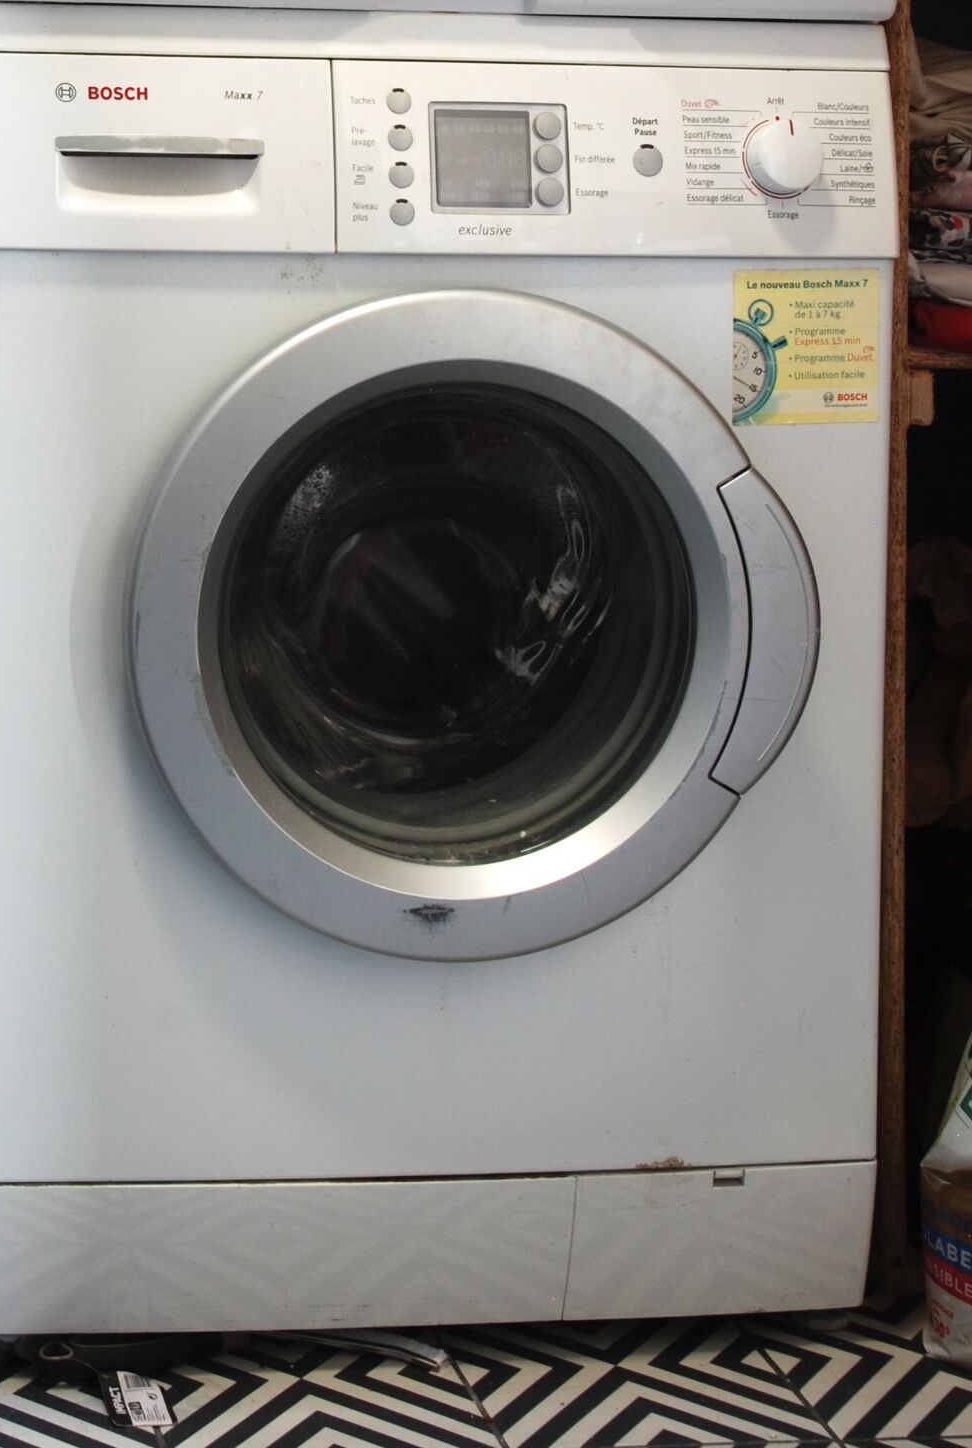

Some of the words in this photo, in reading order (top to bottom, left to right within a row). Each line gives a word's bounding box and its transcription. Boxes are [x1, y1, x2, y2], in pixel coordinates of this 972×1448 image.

[88, 86, 149, 100] BOSCH
[224, 90, 253, 100] Maxx
[257, 91, 263, 100] 7
[350, 97, 376, 105] Taches
[681, 100, 703, 108] Duvet
[767, 97, 784, 105] Arrêt
[818, 103, 869, 111] Blanc/Couleurs
[632, 118, 658, 126] Départ
[682, 116, 699, 124] Peau
[701, 115, 730, 123] sensible
[813, 118, 843, 126] Couleurs
[845, 118, 870, 127] intensif
[574, 122, 595, 131] Temp.
[683, 131, 732, 140] Sport/Fitness
[829, 134, 858, 142] Couleurs
[860, 134, 872, 143] éco
[351, 138, 376, 147] lavage
[685, 147, 712, 156] Express
[723, 147, 736, 155] min
[832, 149, 873, 158] Délicat/Soie
[575, 155, 586, 163] Fin
[587, 155, 615, 164] différée
[352, 164, 374, 172] Facile
[699, 163, 720, 171] rapide
[686, 178, 714, 187] Vidange
[830, 180, 875, 190] Synthétiques
[576, 189, 608, 198] Essorage
[687, 194, 719, 203] Essorage
[720, 194, 743, 202] délicat
[849, 196, 876, 205] Rinçage
[352, 214, 368, 222] plus
[768, 210, 799, 220] Essorage
[458, 224, 512, 236] exclusive
[746, 281, 757, 289] Le
[760, 281, 801, 289] nouveau
[803, 280, 832, 288] Bosch
[835, 280, 860, 288] Maxx
[863, 279, 868, 287] 7
[817, 299, 855, 309] capacité
[816, 310, 820, 318] à
[823, 310, 828, 318] 7
[830, 309, 841, 319] kg
[794, 328, 846, 337] Programme
[794, 338, 829, 347] Express
[844, 337, 861, 345] min
[752, 351, 758, 359] 5
[794, 354, 845, 364] Programme
[847, 353, 873, 362] Duvet
[753, 367, 763, 375] 10
[794, 371, 839, 380] Utilisation
[841, 370, 865, 378] facile
[749, 384, 758, 392] 15
[734, 394, 746, 404] 20
[837, 393, 868, 401] BOSCH
